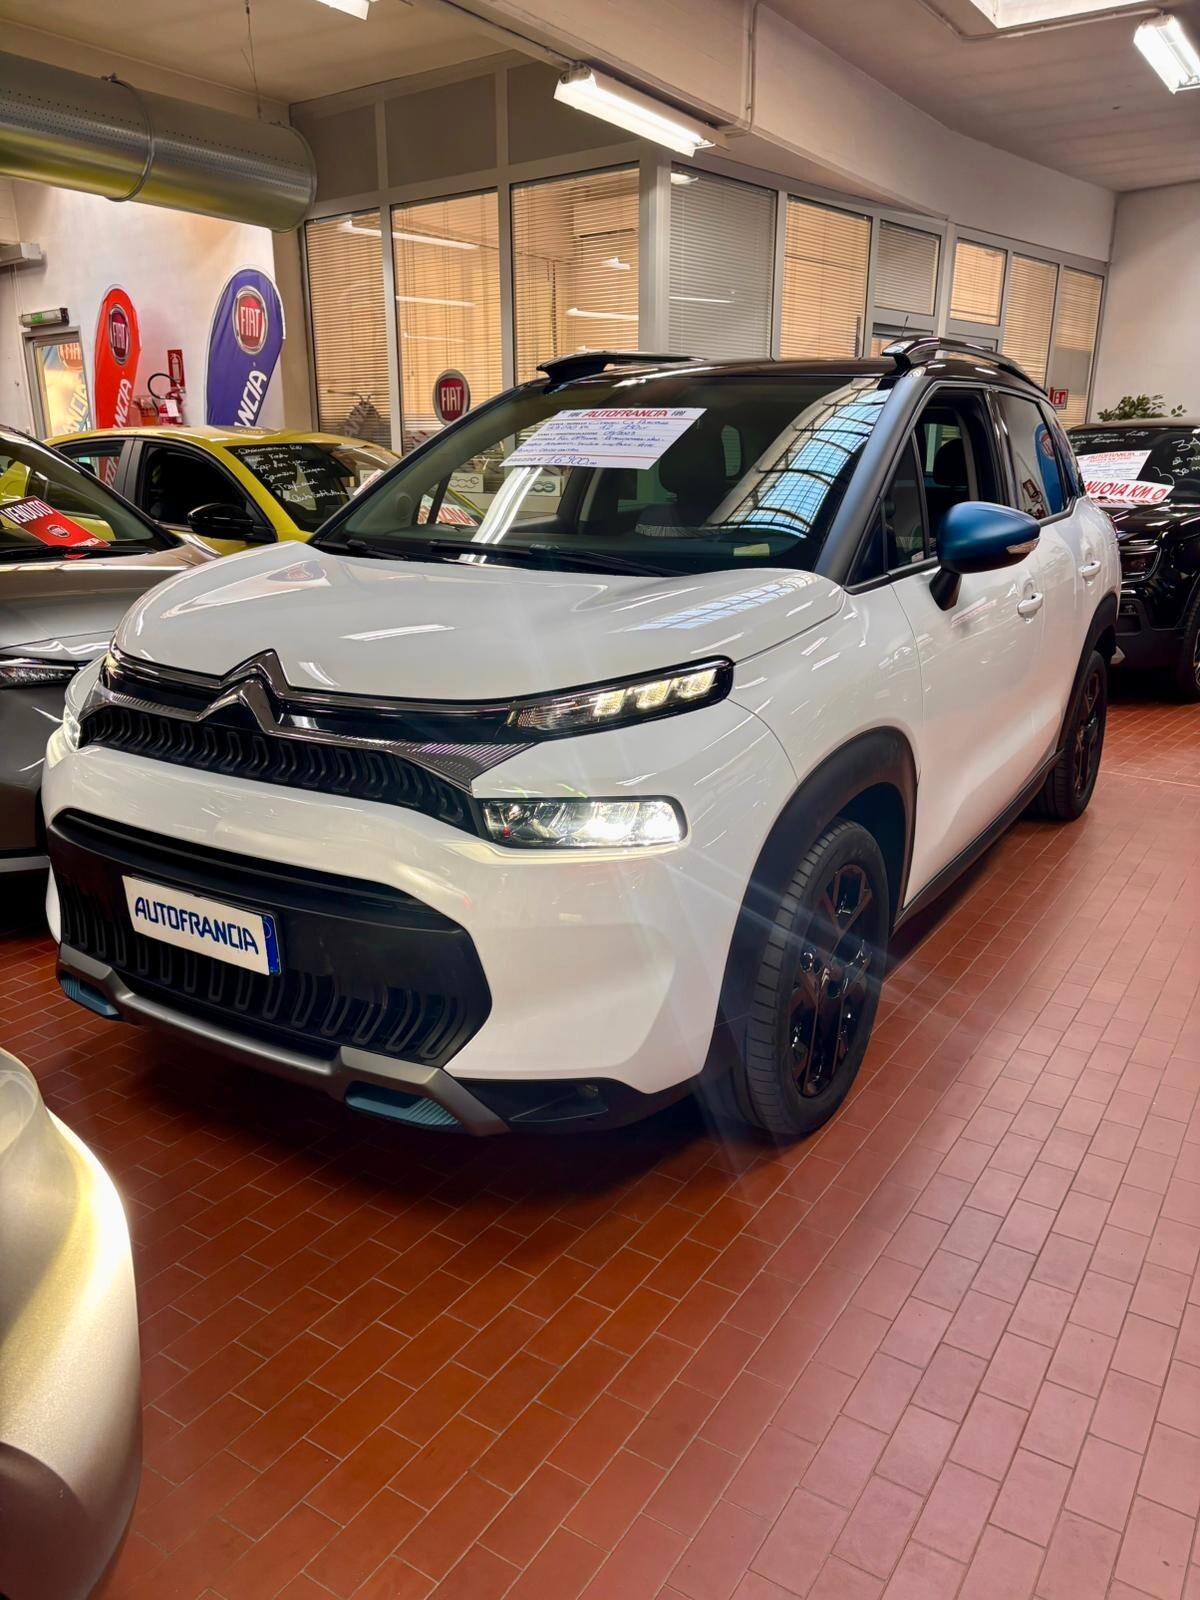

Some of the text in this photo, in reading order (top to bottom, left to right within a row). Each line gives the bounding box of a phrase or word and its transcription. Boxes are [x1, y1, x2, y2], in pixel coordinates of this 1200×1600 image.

[241, 306, 261, 338] FIAT
[113, 378, 133, 429] NCIA
[234, 370, 268, 428] NCIA
[440, 386, 462, 412] FIAT
[582, 409, 669, 418] AUTOFRANCIA
[1085, 480, 1124, 497] NUOVA
[1127, 484, 1153, 499] KM
[0, 500, 54, 524] VENDUTO
[135, 896, 259, 955] AUTOFRANCIA
